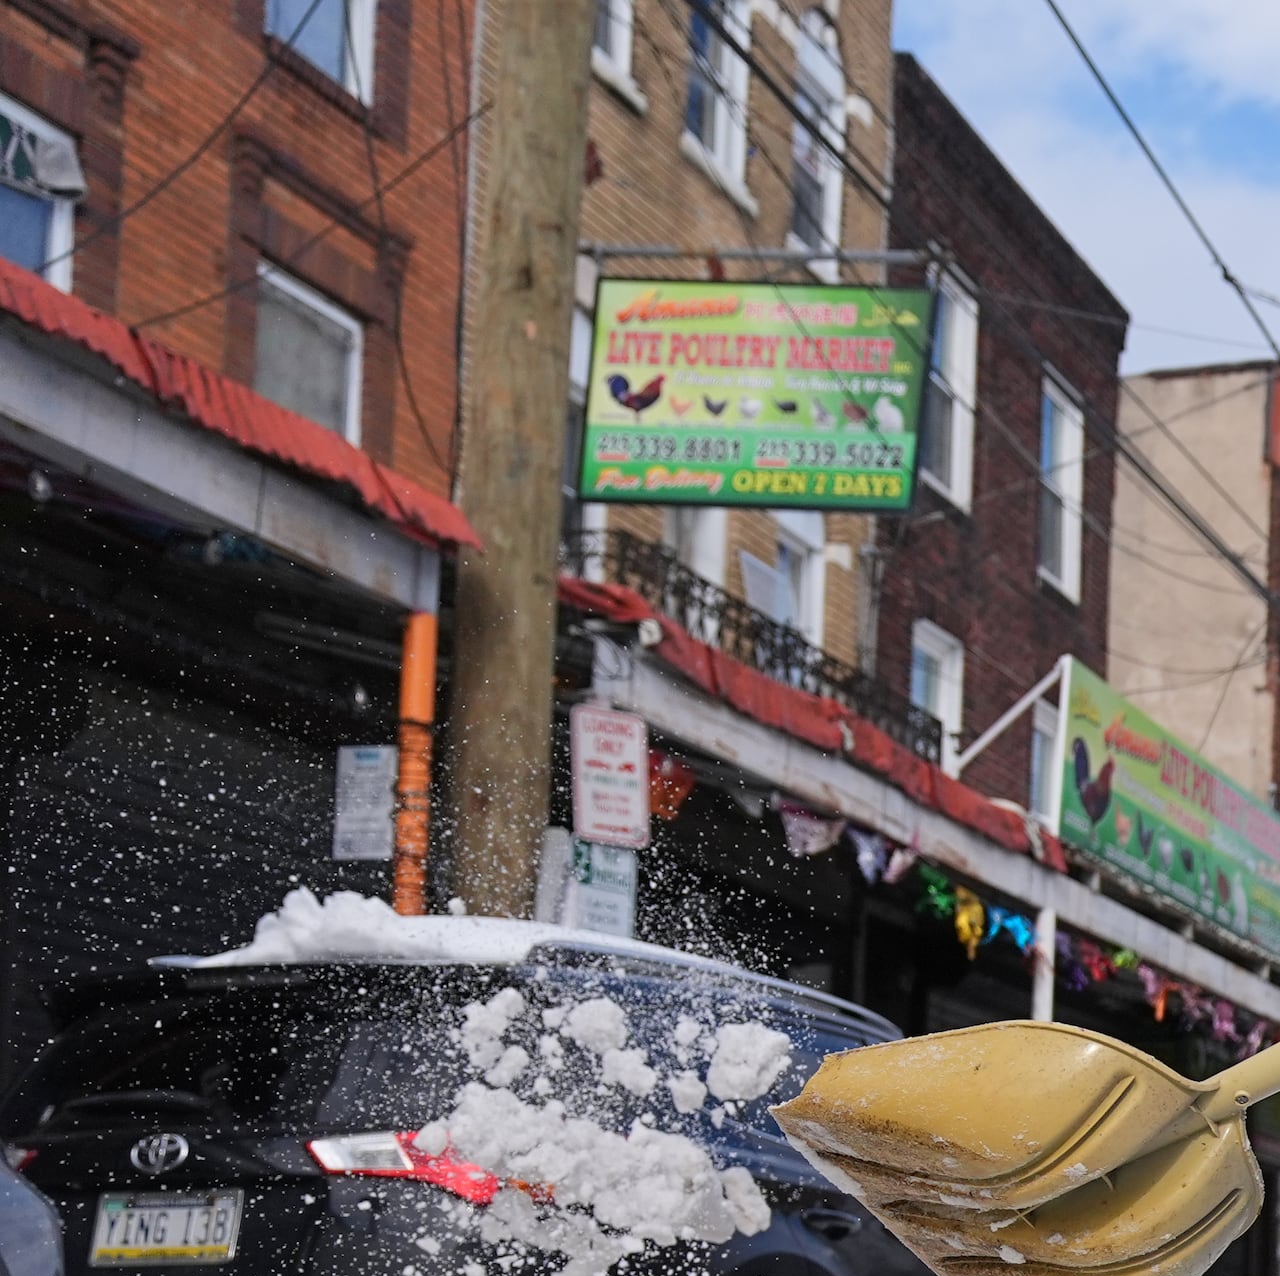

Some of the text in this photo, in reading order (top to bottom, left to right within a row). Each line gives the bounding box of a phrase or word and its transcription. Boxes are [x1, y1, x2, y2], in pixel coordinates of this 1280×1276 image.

[606, 330, 664, 366] LIVE
[668, 332, 782, 369] POULTRY
[786, 336, 896, 374] MARKET
[731, 469, 808, 495] OPEN
[832, 472, 902, 497] DAYS
[106, 1211, 169, 1246] YING
